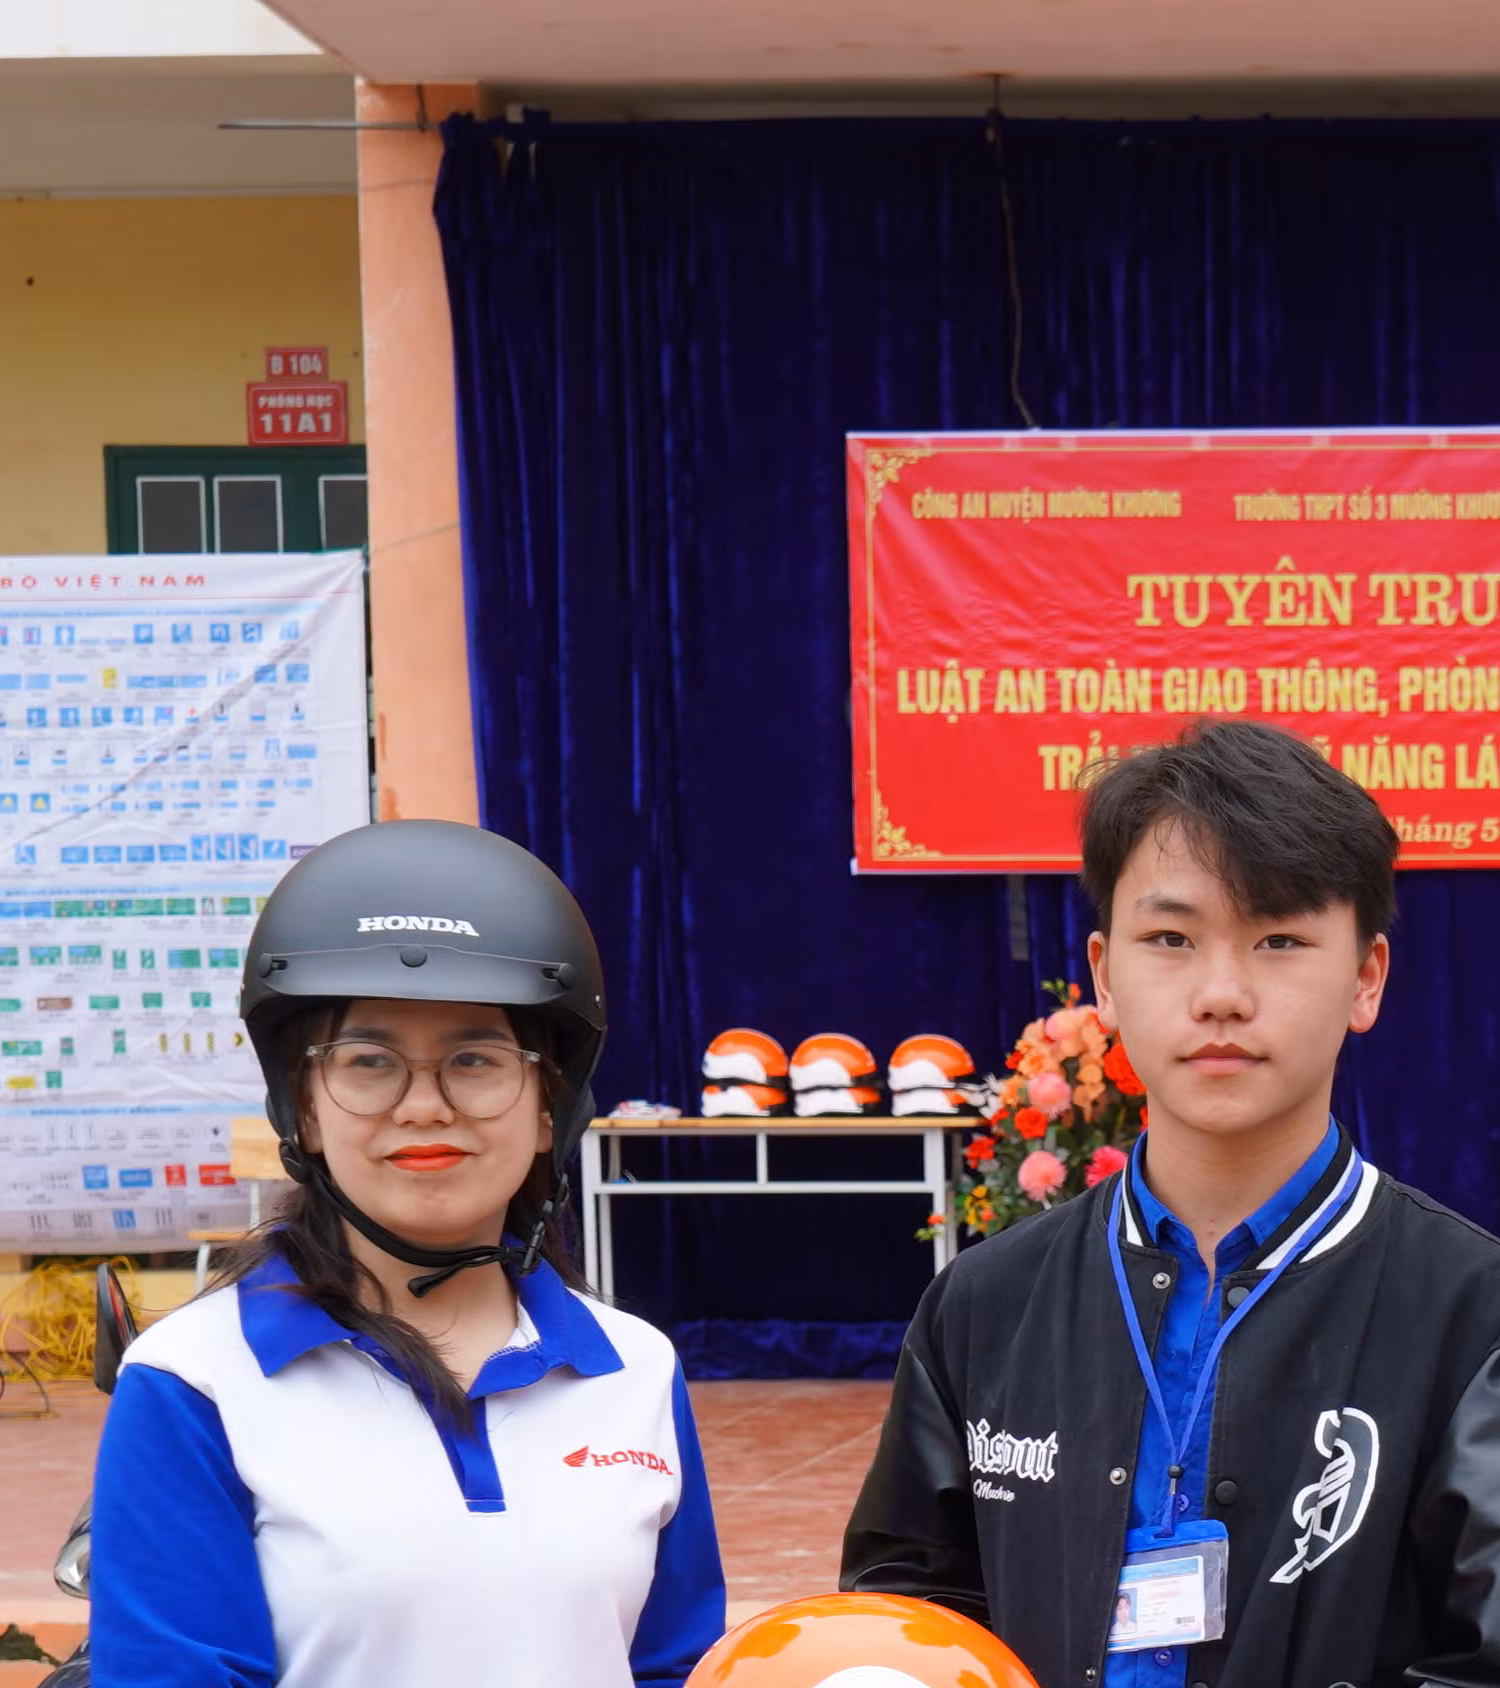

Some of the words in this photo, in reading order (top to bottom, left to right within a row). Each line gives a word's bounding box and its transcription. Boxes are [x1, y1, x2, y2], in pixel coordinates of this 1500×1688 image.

[912, 487, 957, 518] CÔNG
[962, 492, 985, 518] AN
[988, 487, 1044, 524] HUYỆN
[1304, 494, 1345, 520] THPT
[1348, 485, 1372, 520] SỐ
[1375, 494, 1387, 520] 3
[55, 573, 122, 590] VIỆT
[140, 574, 206, 587] NAM
[1127, 555, 1356, 628] TUYÊN
[897, 658, 983, 724] LUẬT
[994, 668, 1047, 714] AN
[1056, 659, 1151, 714] TOÀN
[1161, 667, 1246, 714] GIAO
[1256, 658, 1389, 718] THÔNG,
[1342, 735, 1446, 790] NĂNG
[1480, 817, 1500, 843] 5
[357, 915, 479, 936] HONDA
[591, 1450, 674, 1476] HONDA
